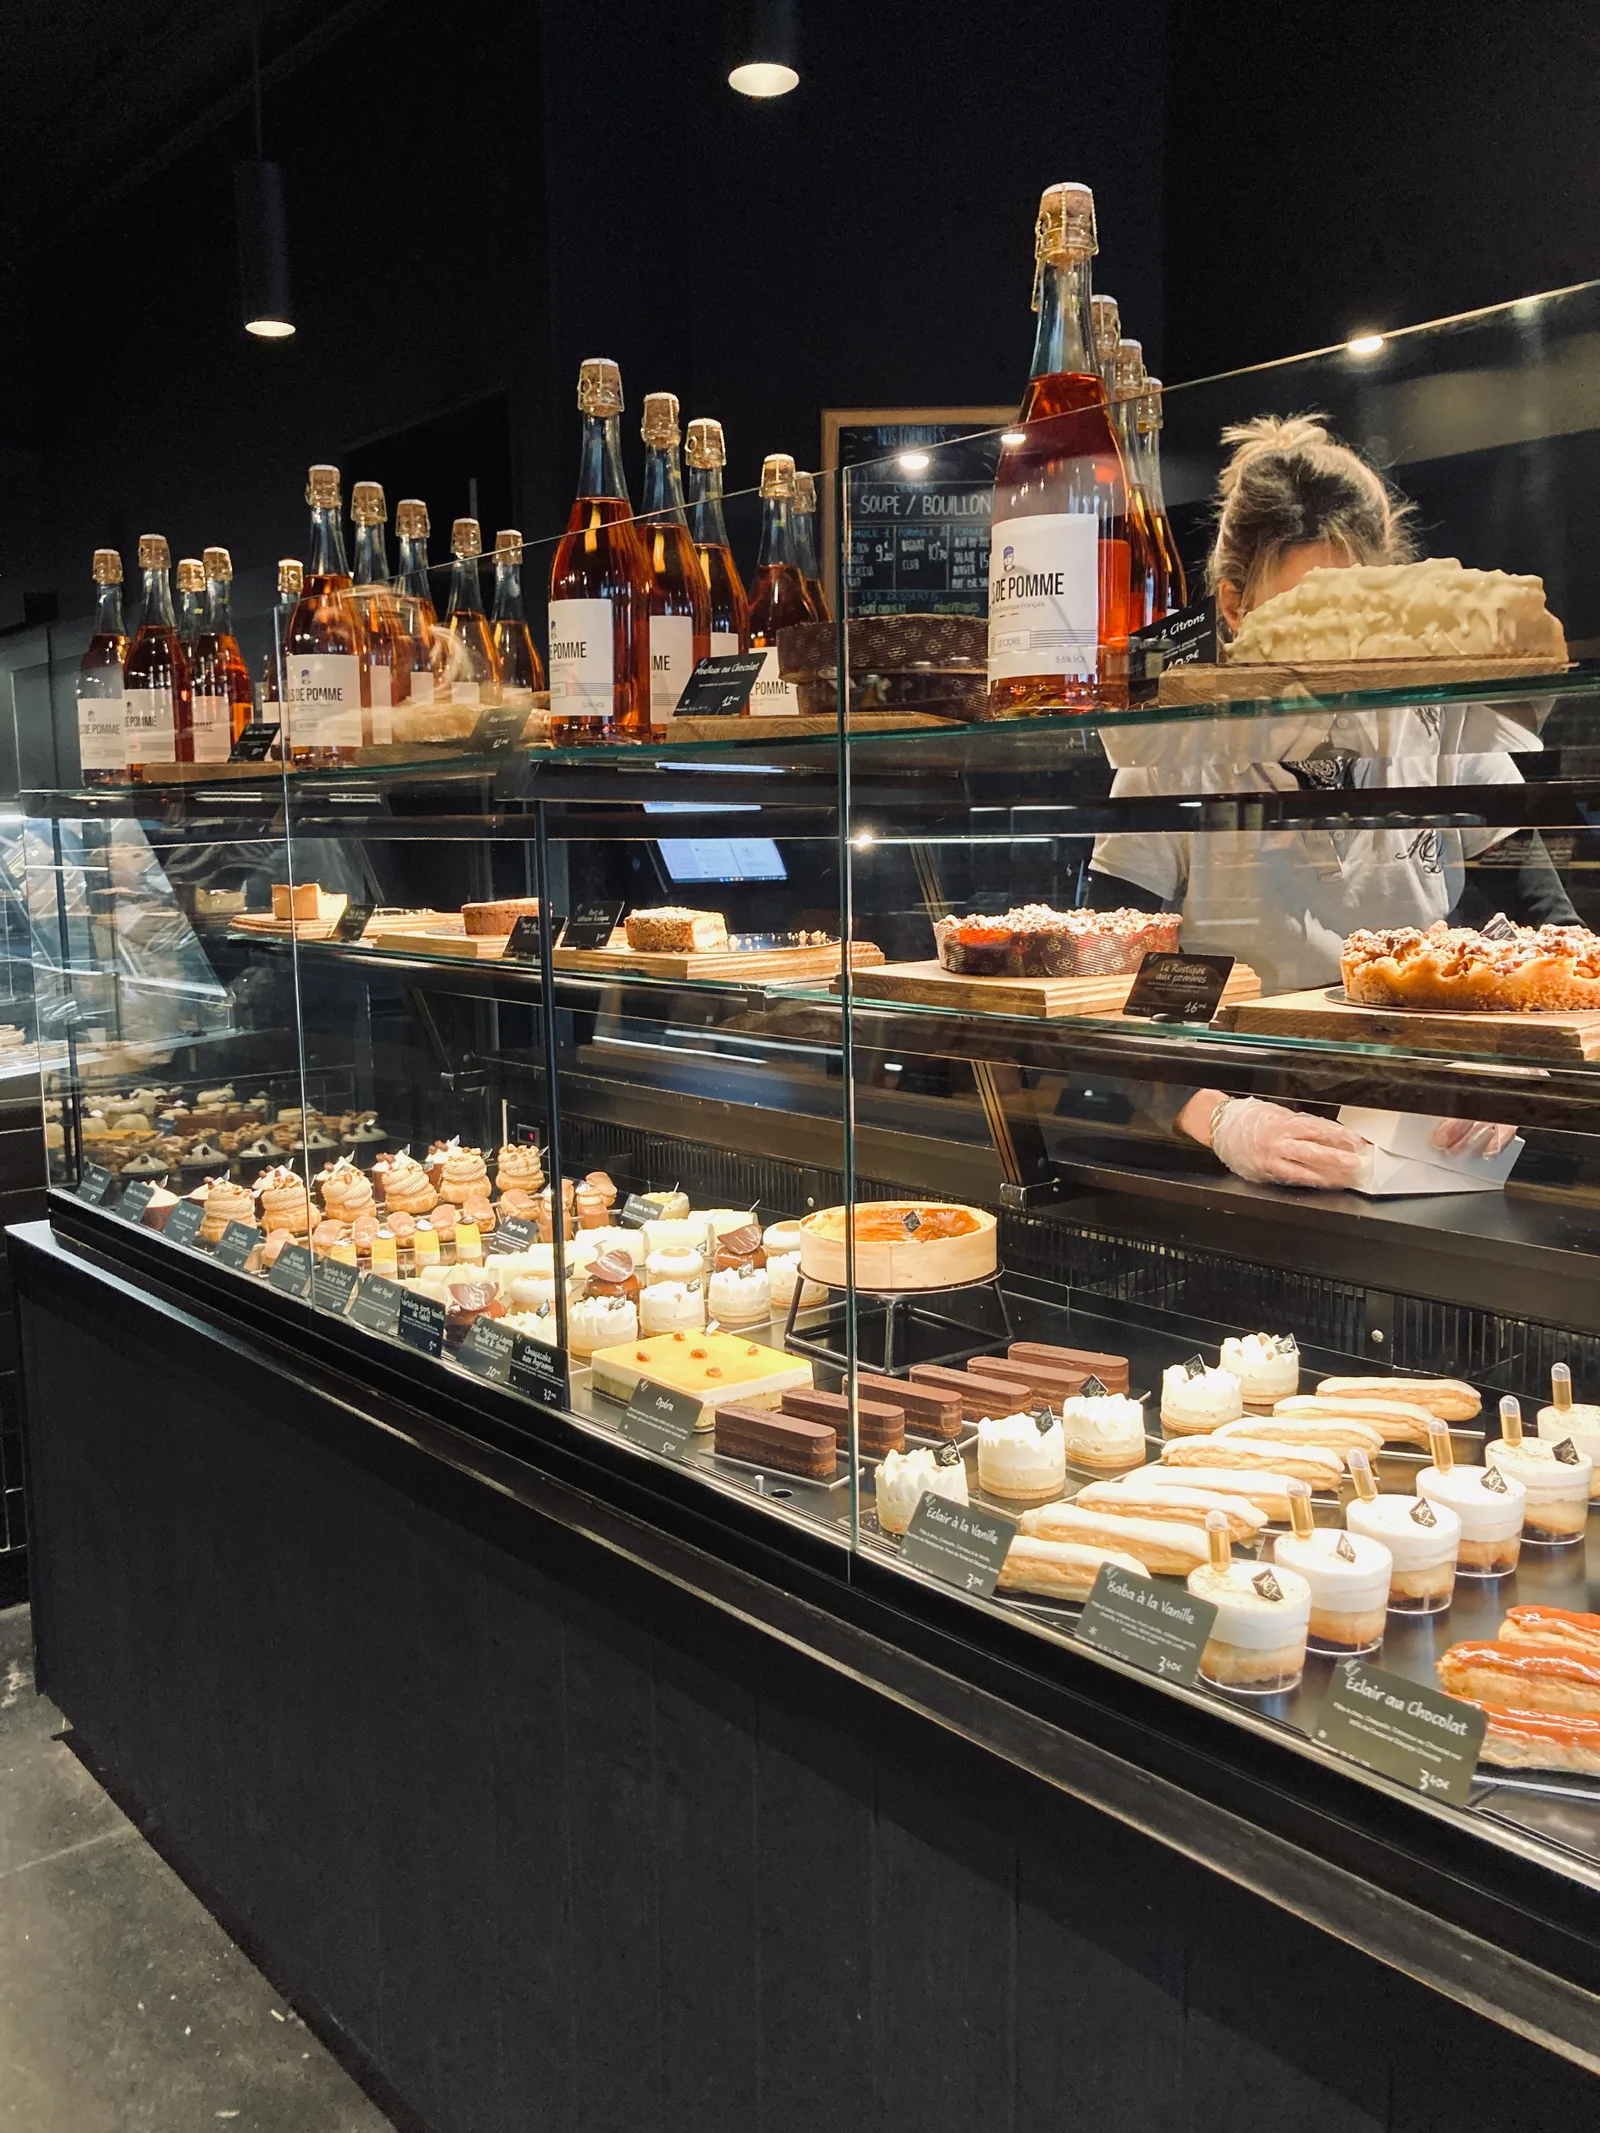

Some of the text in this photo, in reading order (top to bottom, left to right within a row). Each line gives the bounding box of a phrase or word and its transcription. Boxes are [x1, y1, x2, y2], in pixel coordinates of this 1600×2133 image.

[860, 495, 900, 515] SOUPE
[922, 495, 991, 515] BOUILLON
[1008, 573, 1064, 600] POMME
[1170, 612, 1206, 635] Citrons
[553, 641, 587, 659] POMME
[731, 662, 760, 672] Chocolat
[307, 688, 343, 701] POMME
[755, 681, 790, 696] POMME
[1160, 963, 1207, 976] Le Rustique
[1172, 975, 1207, 984] pommes
[656, 1396, 674, 1412] Opéra
[951, 1516, 959, 1529] à
[960, 1518, 970, 1533] la
[971, 1524, 999, 1545] Vanille
[1107, 1579, 1135, 1601] Baba
[1136, 1590, 1145, 1606] à
[1146, 1593, 1159, 1611] la
[1161, 1600, 1195, 1625] Vanille
[1384, 1693, 1405, 1712] au
[1407, 1701, 1468, 1737] Chocolat
